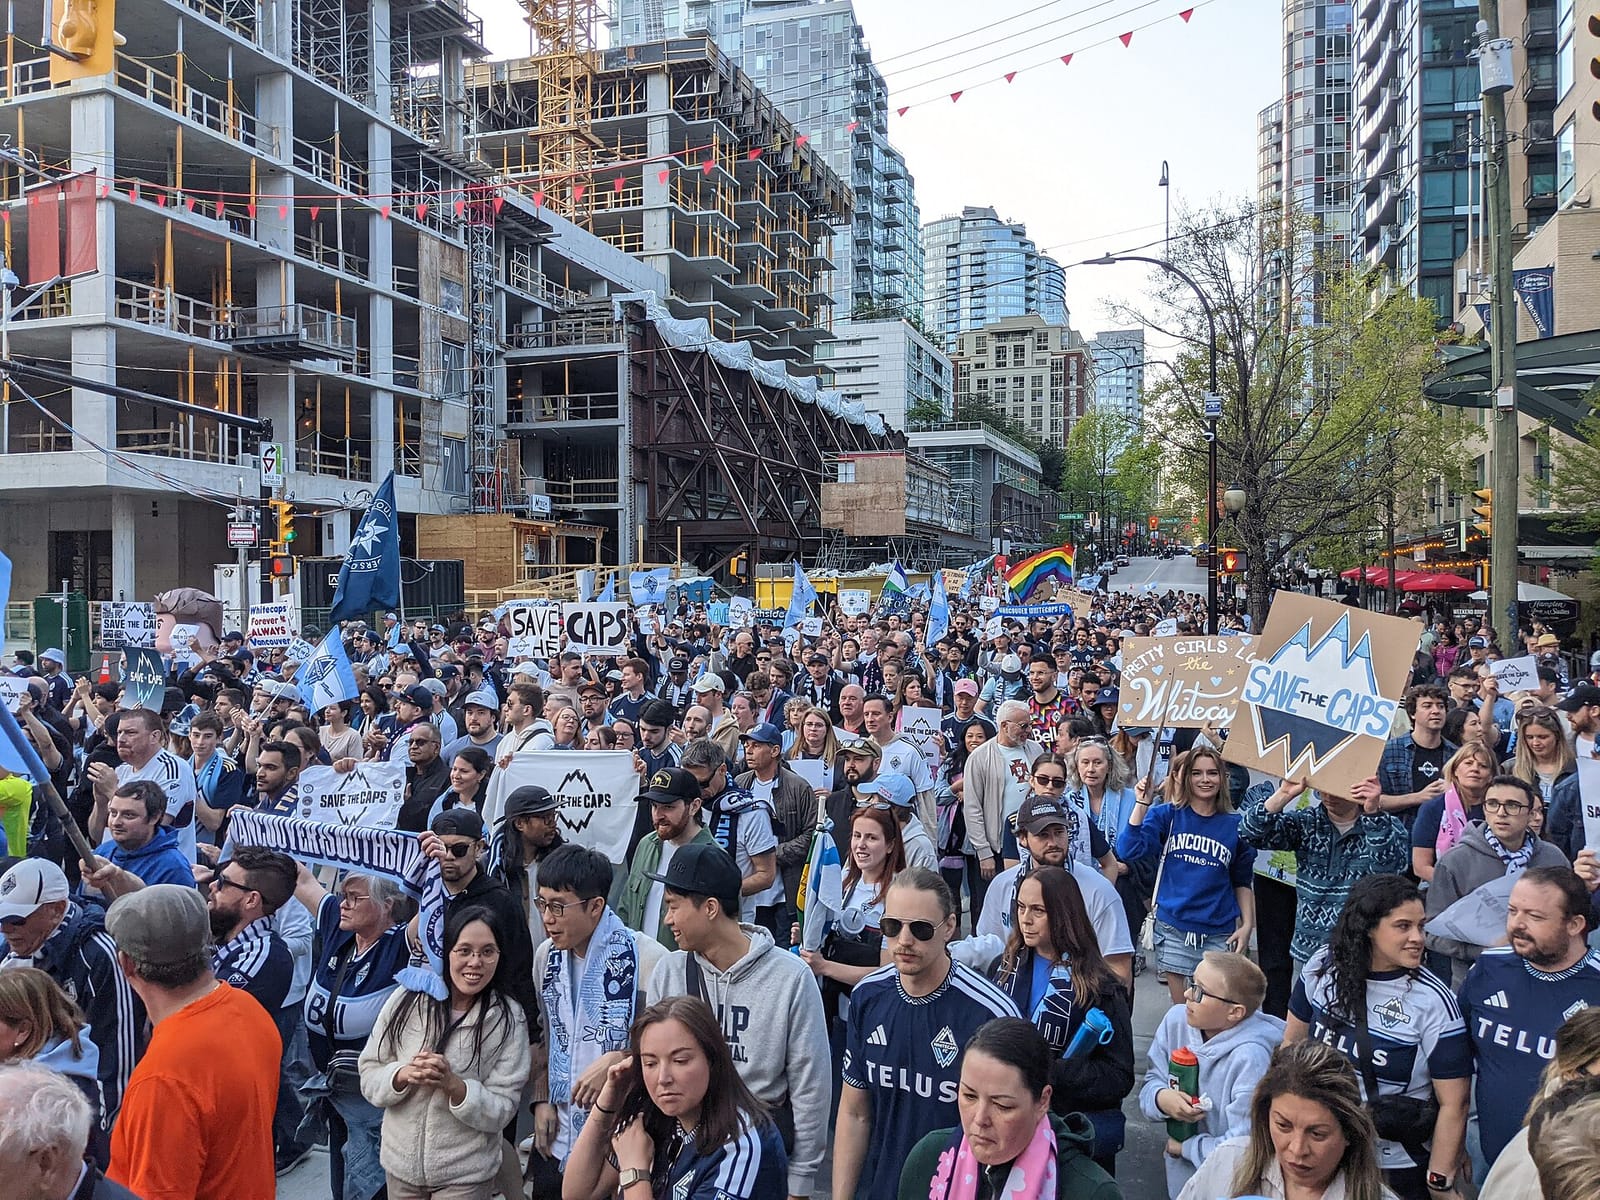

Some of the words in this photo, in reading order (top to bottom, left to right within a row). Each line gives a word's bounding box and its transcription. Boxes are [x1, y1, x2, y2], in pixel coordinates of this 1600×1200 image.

[1524, 296, 1546, 332] Vancouver
[1000, 606, 1028, 614] VANCOUVER
[1028, 606, 1058, 614] WHITECAPS
[1529, 600, 1566, 608] Hampton
[104, 619, 126, 629] SAVE
[128, 620, 140, 628] THE
[251, 616, 278, 626] Forever
[251, 626, 286, 636] ALWAYS
[513, 608, 558, 640] SAVE
[566, 610, 627, 646] CAPS
[1121, 644, 1164, 682] PRETTY
[1174, 640, 1228, 654] GIRLS
[1178, 656, 1214, 671] the
[1245, 666, 1309, 714] SAVE
[1300, 690, 1328, 708] THE
[1326, 688, 1394, 736] CAPS
[1032, 726, 1057, 742] Bell
[320, 794, 346, 808] SAVE
[348, 794, 360, 804] THE
[360, 790, 388, 804] CAPS
[567, 796, 582, 808] THE
[584, 794, 612, 808] CAPS
[230, 812, 322, 854] VANCOUVER
[308, 992, 347, 1034] Bll
[1314, 1020, 1388, 1067] TELS
[1478, 1016, 1557, 1060] TELU
[866, 1060, 958, 1102] TELUS
